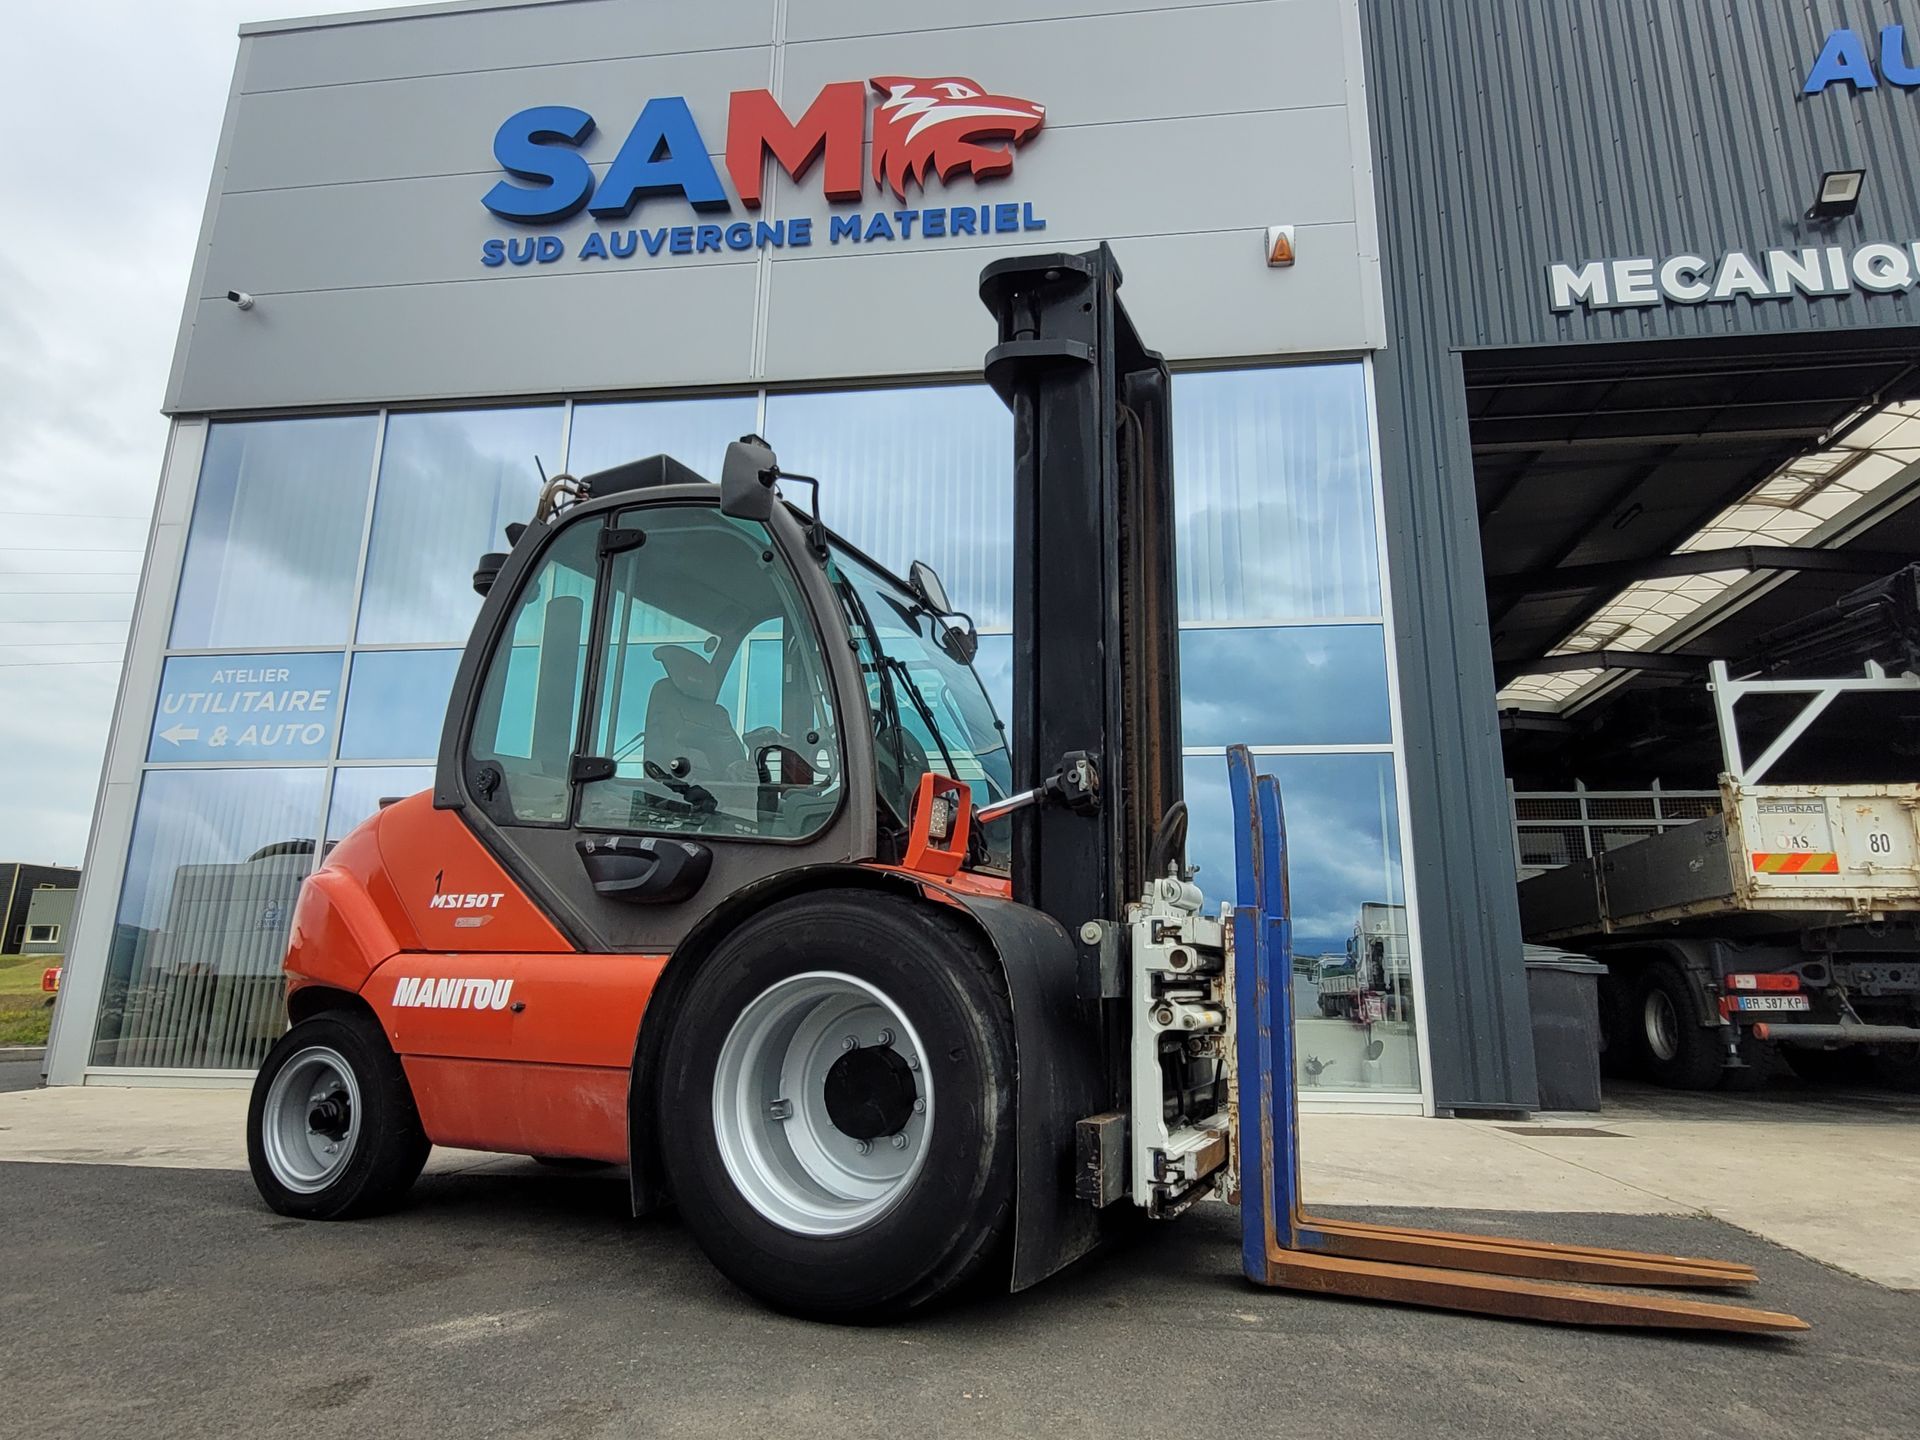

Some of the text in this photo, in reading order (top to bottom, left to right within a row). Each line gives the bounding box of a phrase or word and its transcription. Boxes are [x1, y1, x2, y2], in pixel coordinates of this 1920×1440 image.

[481, 80, 866, 223] SAM
[481, 201, 1047, 267] SUD AUVERGNE MATERIEL
[211, 668, 290, 684] ATELIER
[162, 690, 332, 714] UTILITAIRE
[208, 723, 326, 747] & AUTO
[1869, 833, 1891, 853] 80
[392, 977, 514, 1011] MANITOU
